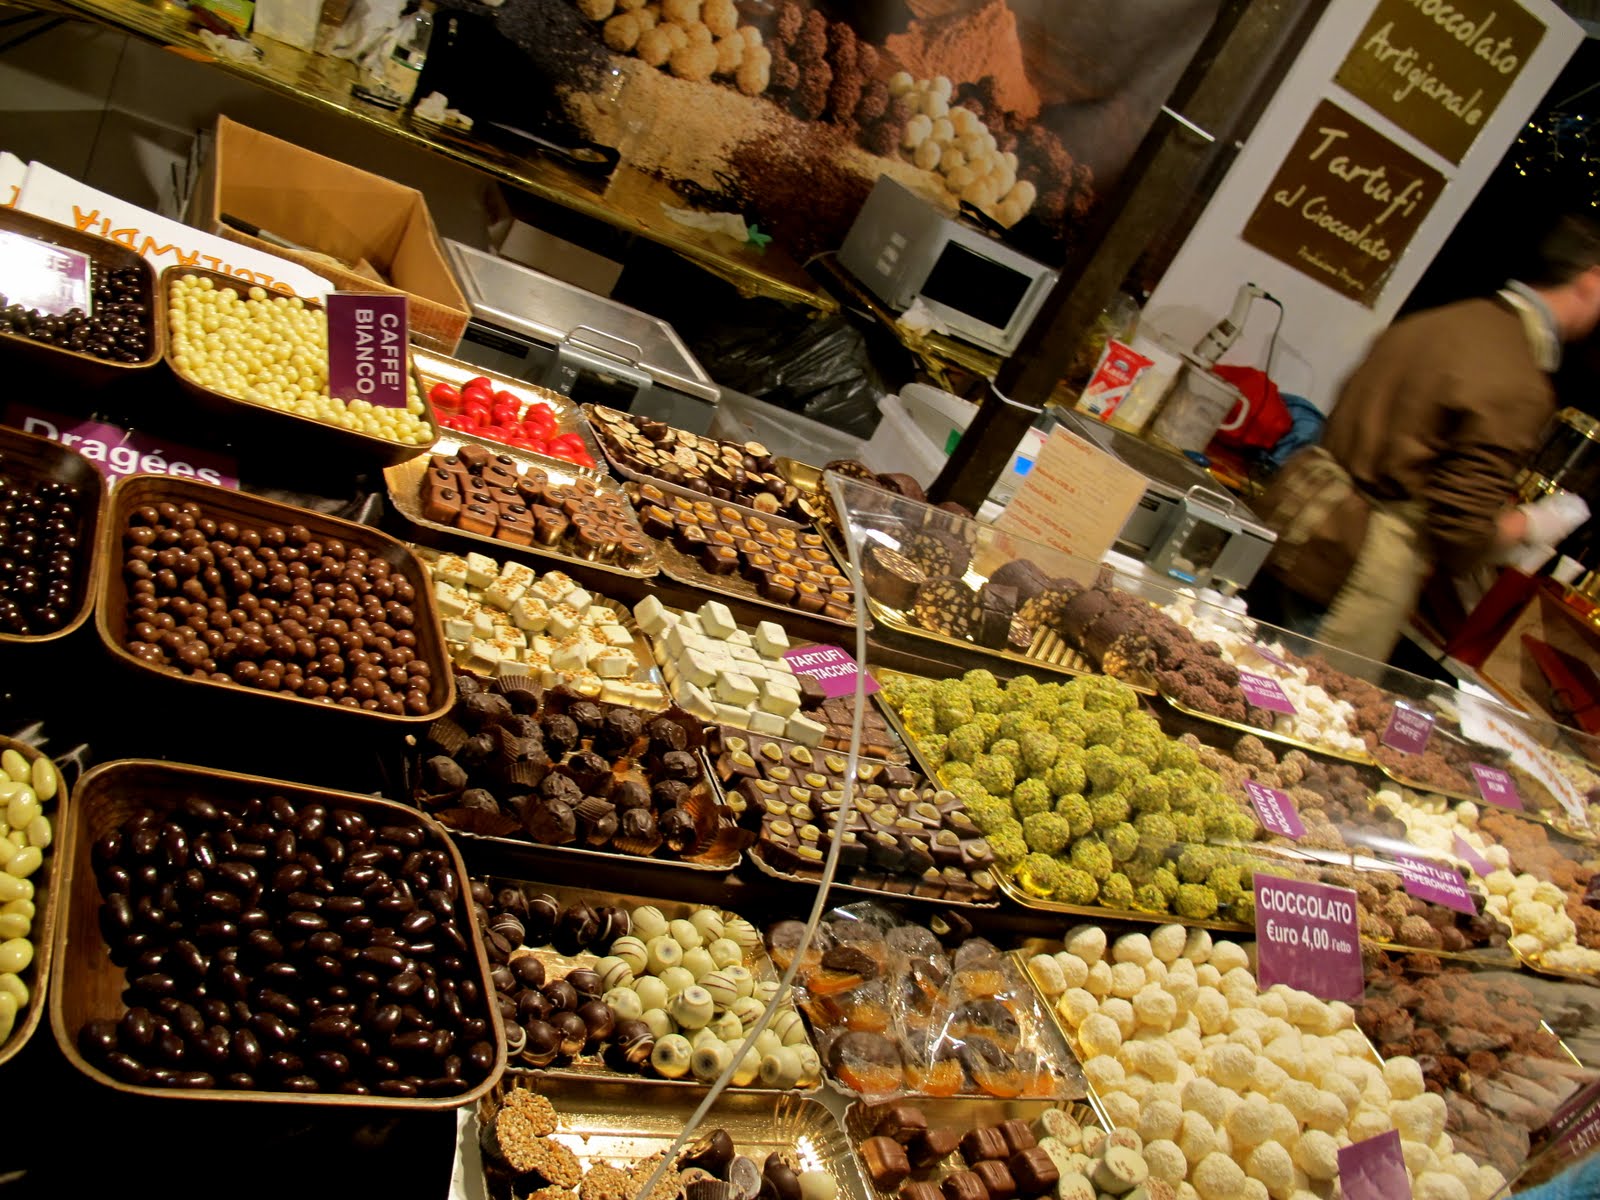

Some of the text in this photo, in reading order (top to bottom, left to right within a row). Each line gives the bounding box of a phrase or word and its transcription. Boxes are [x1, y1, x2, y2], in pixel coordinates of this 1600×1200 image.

[1363, 21, 1483, 125] Artigianale
[1309, 127, 1424, 224] Tartufi
[1274, 185, 1392, 262] al Cioccolato
[355, 309, 376, 394] BIANCO
[379, 313, 400, 391] CAFFE'
[23, 416, 221, 486] Dragées
[786, 649, 845, 668] TARTUFI
[796, 662, 859, 681] STACCHIO
[1248, 783, 1277, 826] TARTUFI
[1401, 856, 1458, 884] TARTUFI
[1402, 868, 1466, 898] PEPERONCINO
[1260, 887, 1352, 925] CIOCCOLATO
[1302, 925, 1329, 951] 4,00
